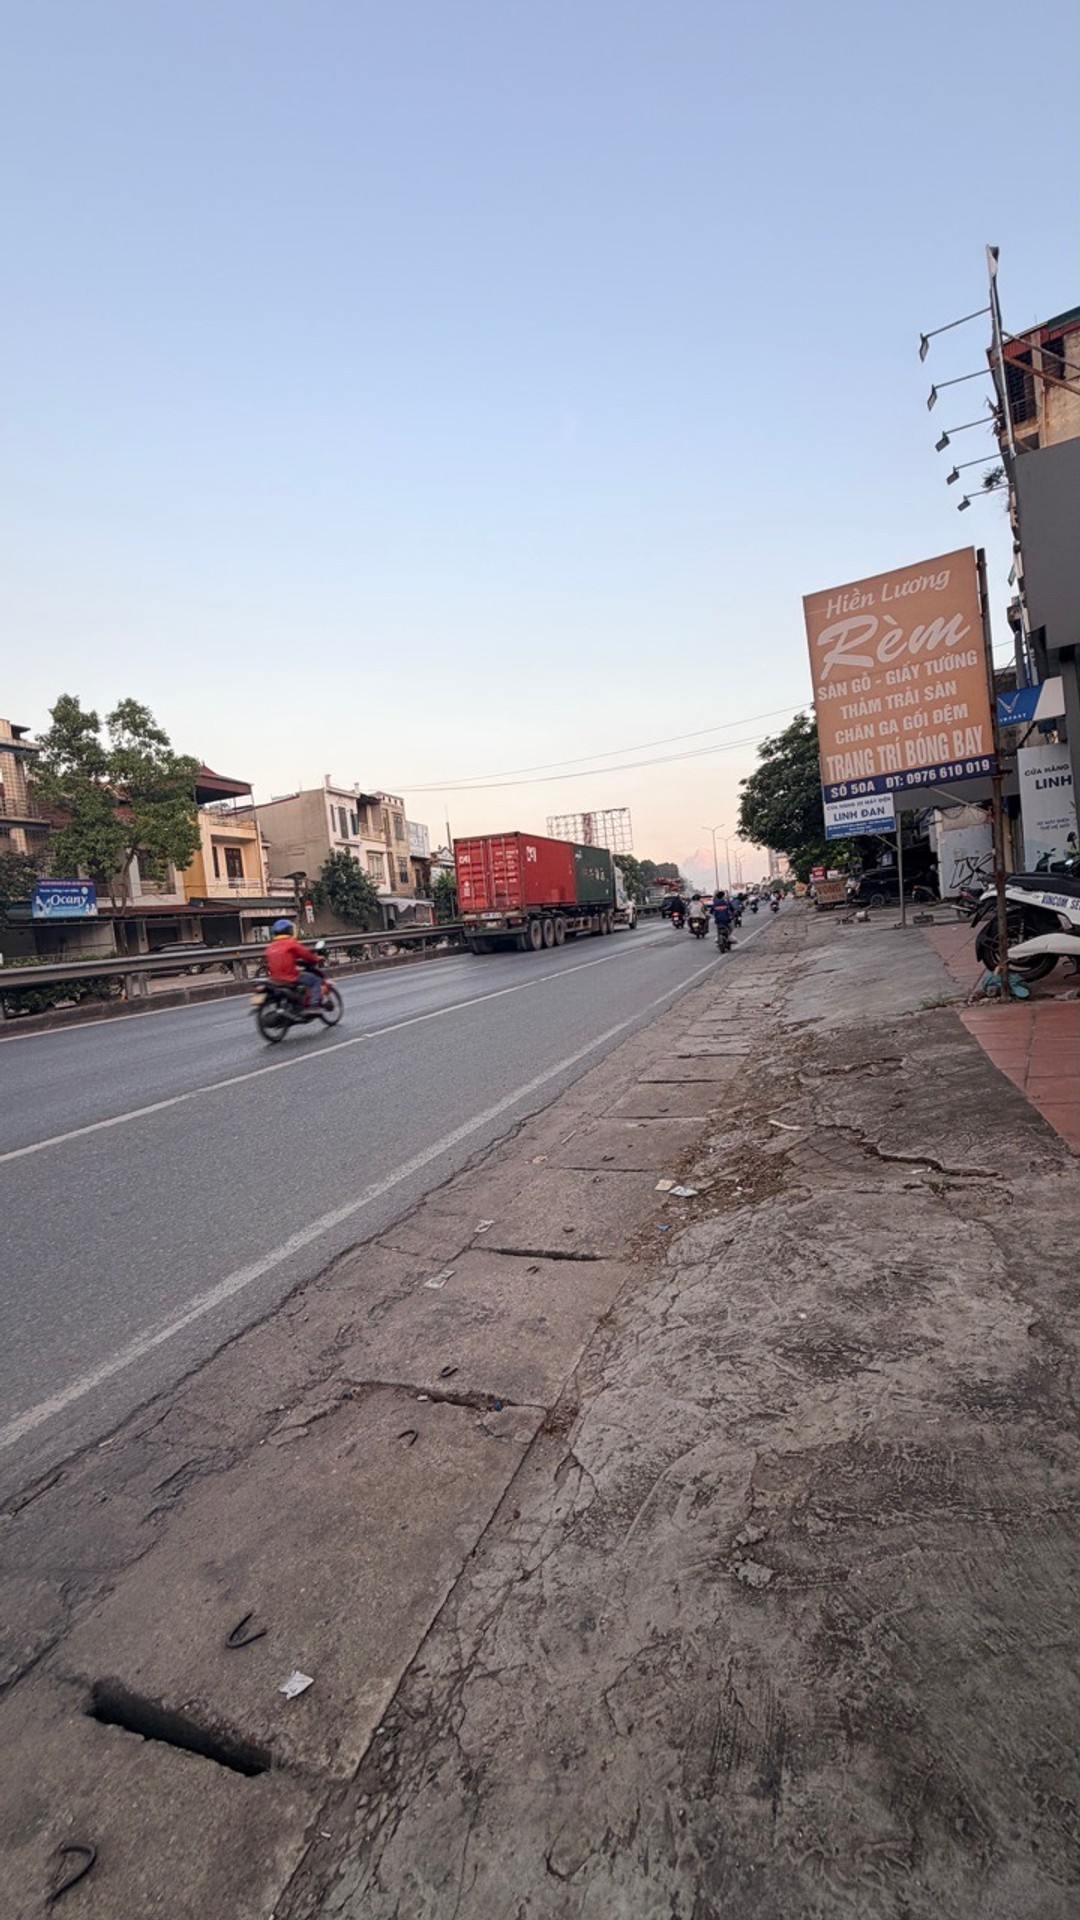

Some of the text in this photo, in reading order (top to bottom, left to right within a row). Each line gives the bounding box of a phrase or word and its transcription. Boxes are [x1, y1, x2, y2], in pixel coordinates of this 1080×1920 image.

[826, 570, 951, 619] Hiền Lương
[817, 613, 970, 680] Rèm
[818, 681, 847, 701] SÀN
[886, 661, 920, 685] GIẤY
[924, 649, 979, 676] TƯỜNG
[840, 680, 957, 720] THẢM TRẢI SÀN
[835, 703, 968, 745] CHĂN GA GỐI ĐỆM
[826, 725, 984, 782] TRANG TRÍ BÓNG BAY
[830, 759, 991, 799] SỐ 50A ĐT: 0976 610 019
[1035, 775, 1072, 790] LINH
[834, 810, 858, 822] LINH
[51, 894, 87, 908] Ocany
